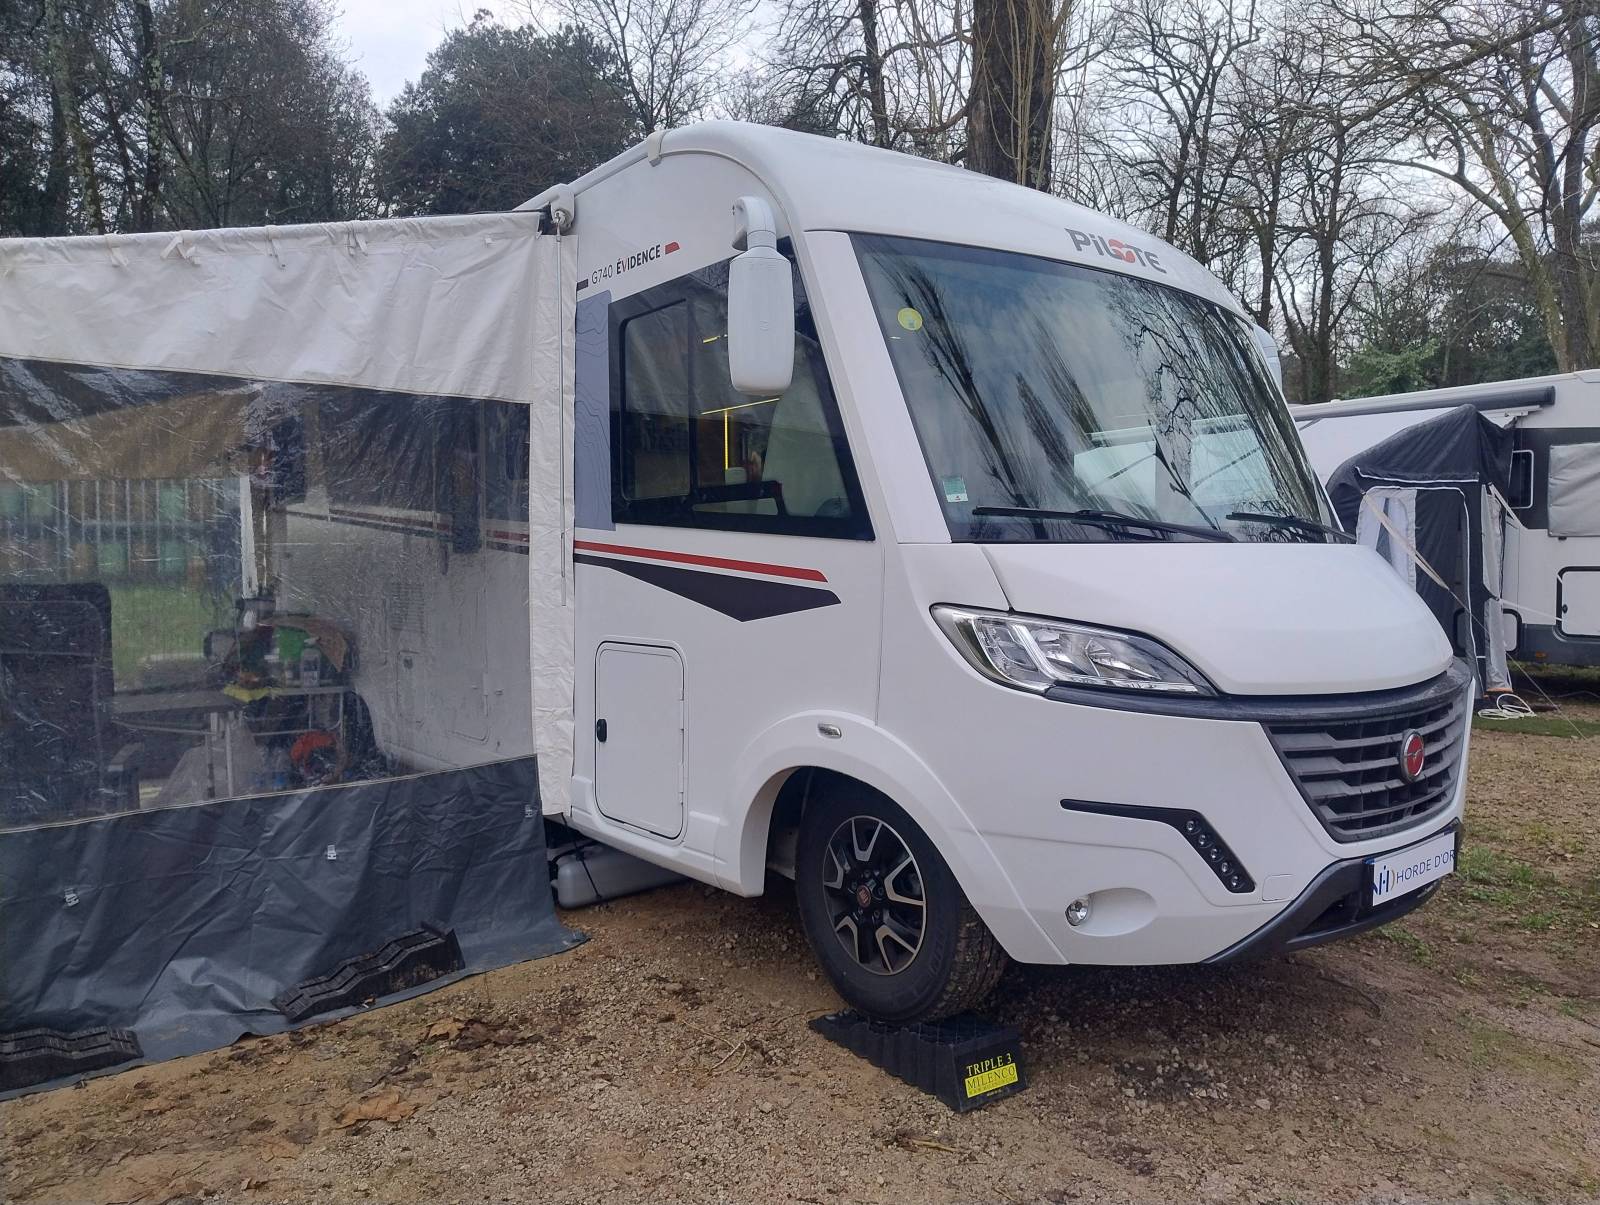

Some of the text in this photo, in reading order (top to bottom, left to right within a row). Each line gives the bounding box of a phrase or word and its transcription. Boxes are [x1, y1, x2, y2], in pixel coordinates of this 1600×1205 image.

[591, 244, 661, 284] G740 ÉVIDENCE
[966, 1052, 1012, 1077] TRIPLE 3
[967, 1065, 1015, 1089] MILENCO
